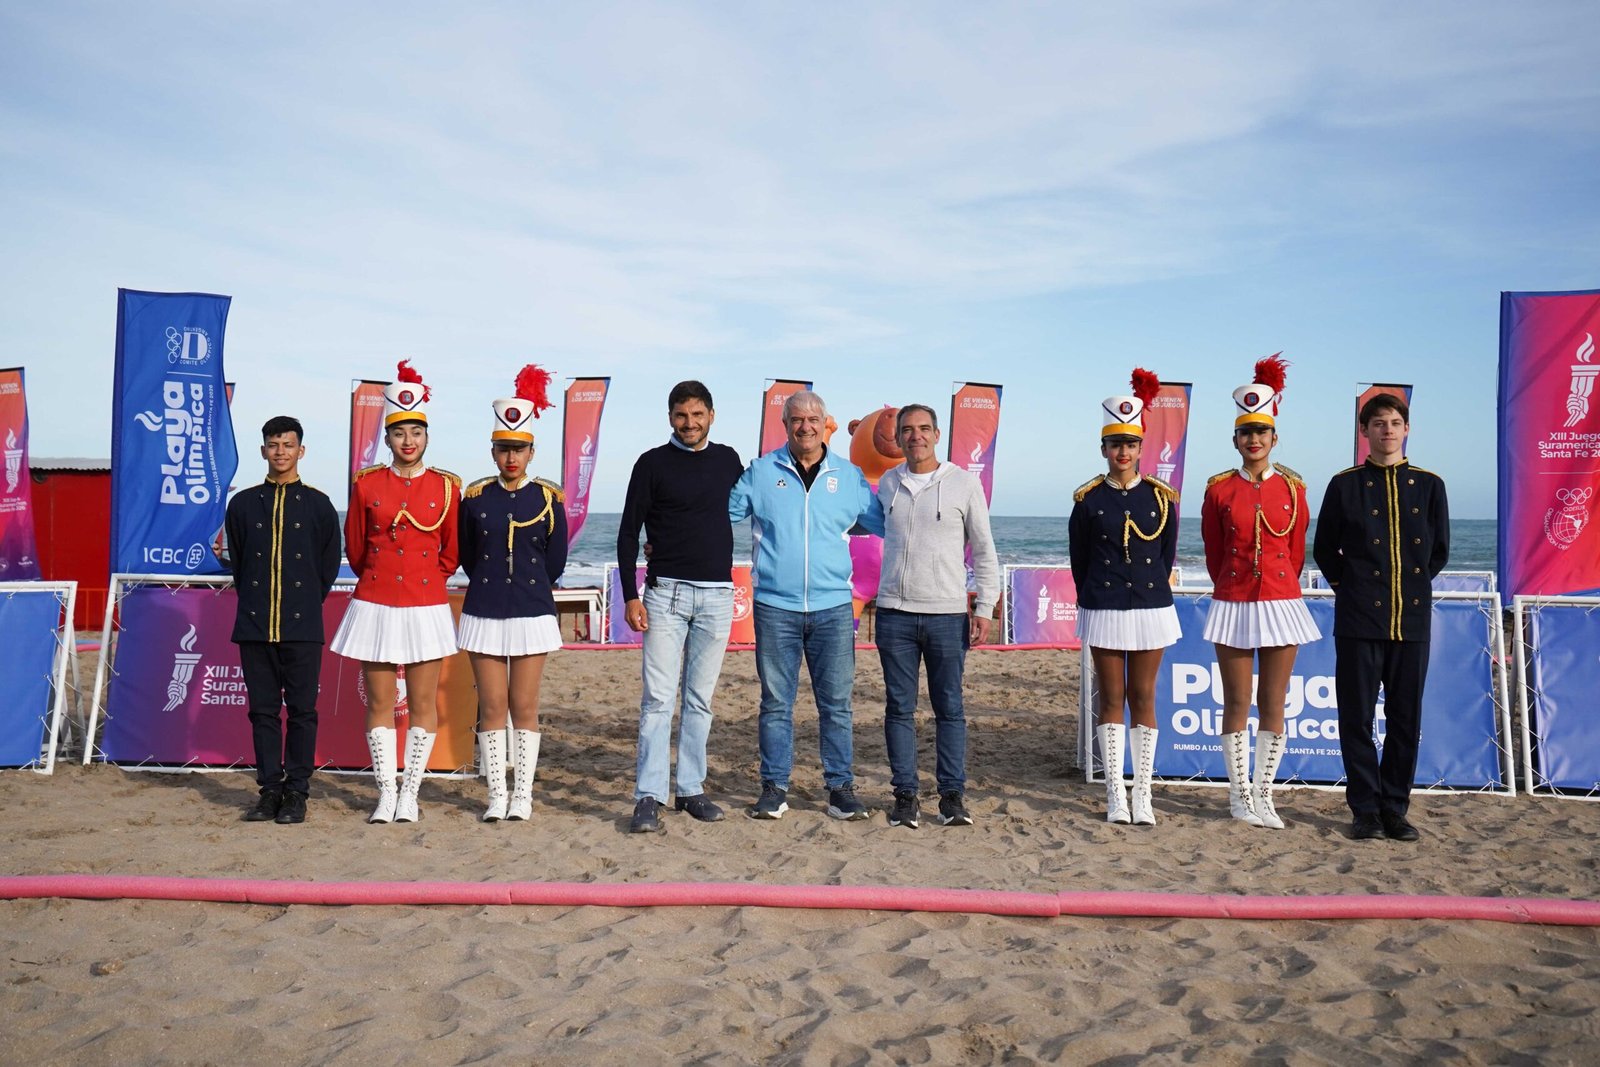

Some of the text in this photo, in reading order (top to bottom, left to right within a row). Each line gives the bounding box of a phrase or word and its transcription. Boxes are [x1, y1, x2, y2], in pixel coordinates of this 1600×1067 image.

[160, 381, 192, 505] Playa
[185, 383, 211, 505] Olímpica
[1549, 432, 1567, 441] XIII
[206, 426, 217, 471] SURAMERICANOS
[1541, 449, 1571, 458] Santa
[1574, 449, 1589, 458] Fe
[143, 547, 184, 564] ICBC
[204, 665, 228, 678] XIII
[200, 692, 246, 705] Santa
[1172, 662, 1338, 719] Plya
